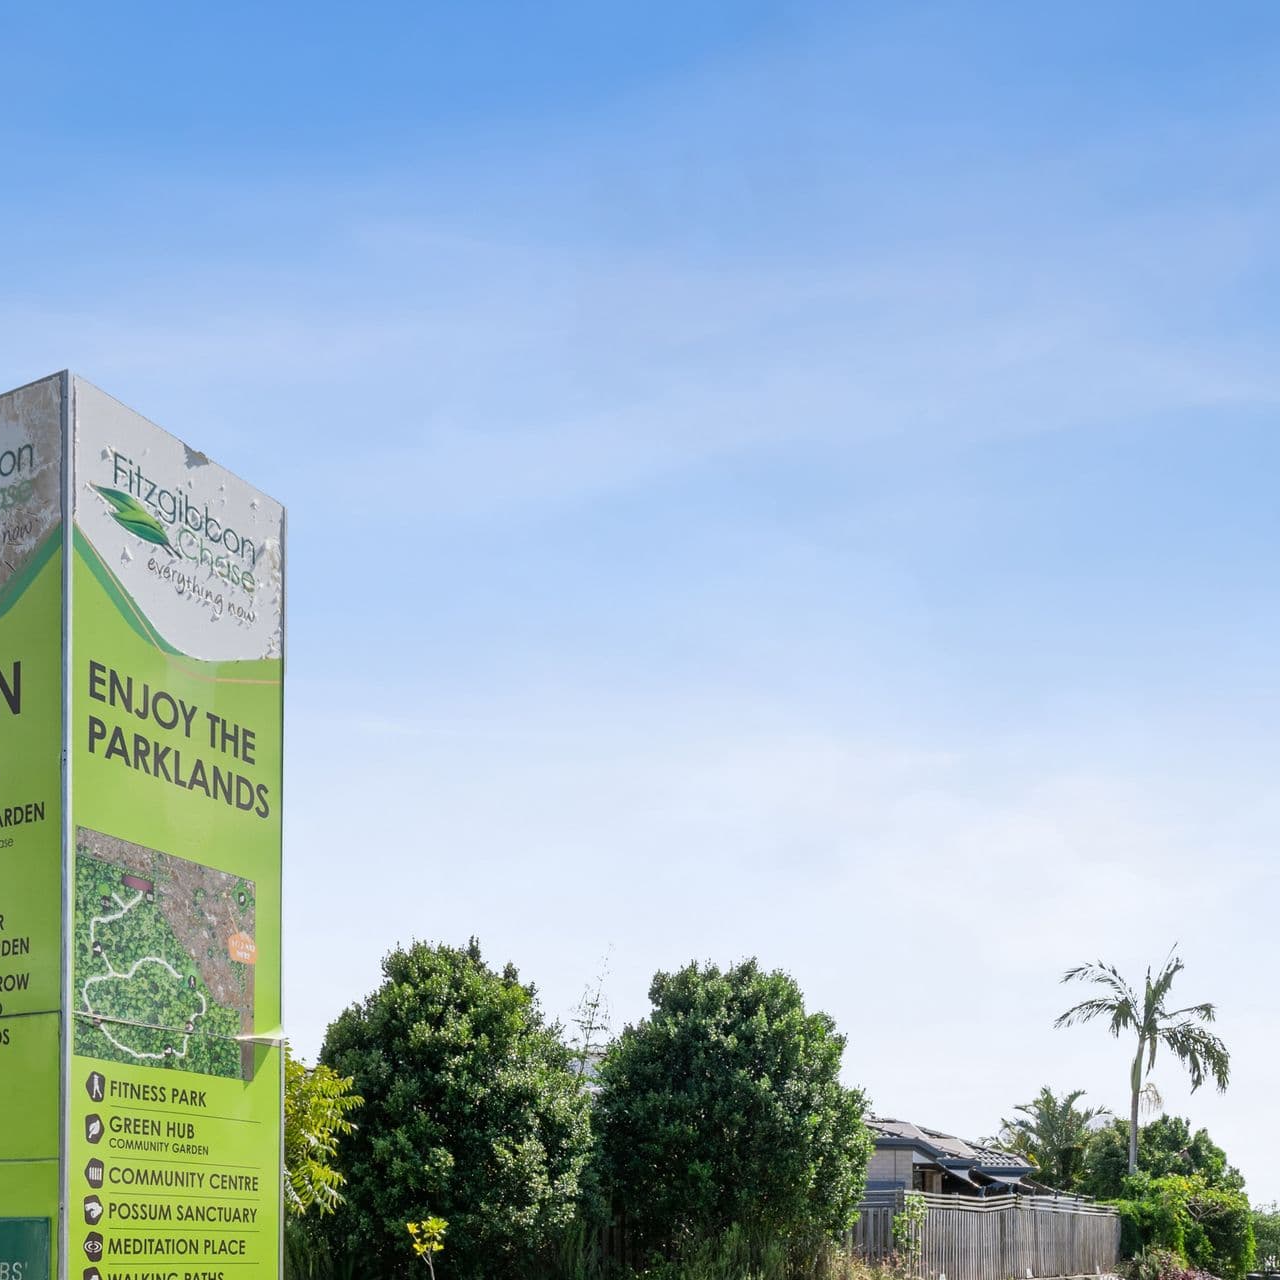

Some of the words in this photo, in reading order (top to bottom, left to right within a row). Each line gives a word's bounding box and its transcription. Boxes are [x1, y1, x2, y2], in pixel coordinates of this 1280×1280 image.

[113, 452, 256, 565] Fitzgibbon
[2, 521, 34, 543] now
[178, 528, 256, 592] Chase
[147, 557, 224, 614] everything
[227, 601, 256, 623] now
[89, 659, 198, 738] ENJOY
[206, 711, 256, 765] THE
[88, 714, 270, 819] PARKLANDS
[110, 1080, 167, 1102] FITNESS
[171, 1088, 207, 1108] PARK
[109, 1116, 161, 1137] GREEN
[166, 1121, 195, 1139] HUB
[109, 1137, 169, 1153] COMMUNITY
[172, 1142, 209, 1156] GARDEN
[109, 1167, 205, 1188] COMMUNITY
[209, 1173, 259, 1191] CENTRE
[109, 1202, 172, 1221] POSSUM
[176, 1204, 258, 1224] SANCTUARY
[108, 1238, 199, 1255] MEDITATION
[204, 1239, 246, 1255] PLACE
